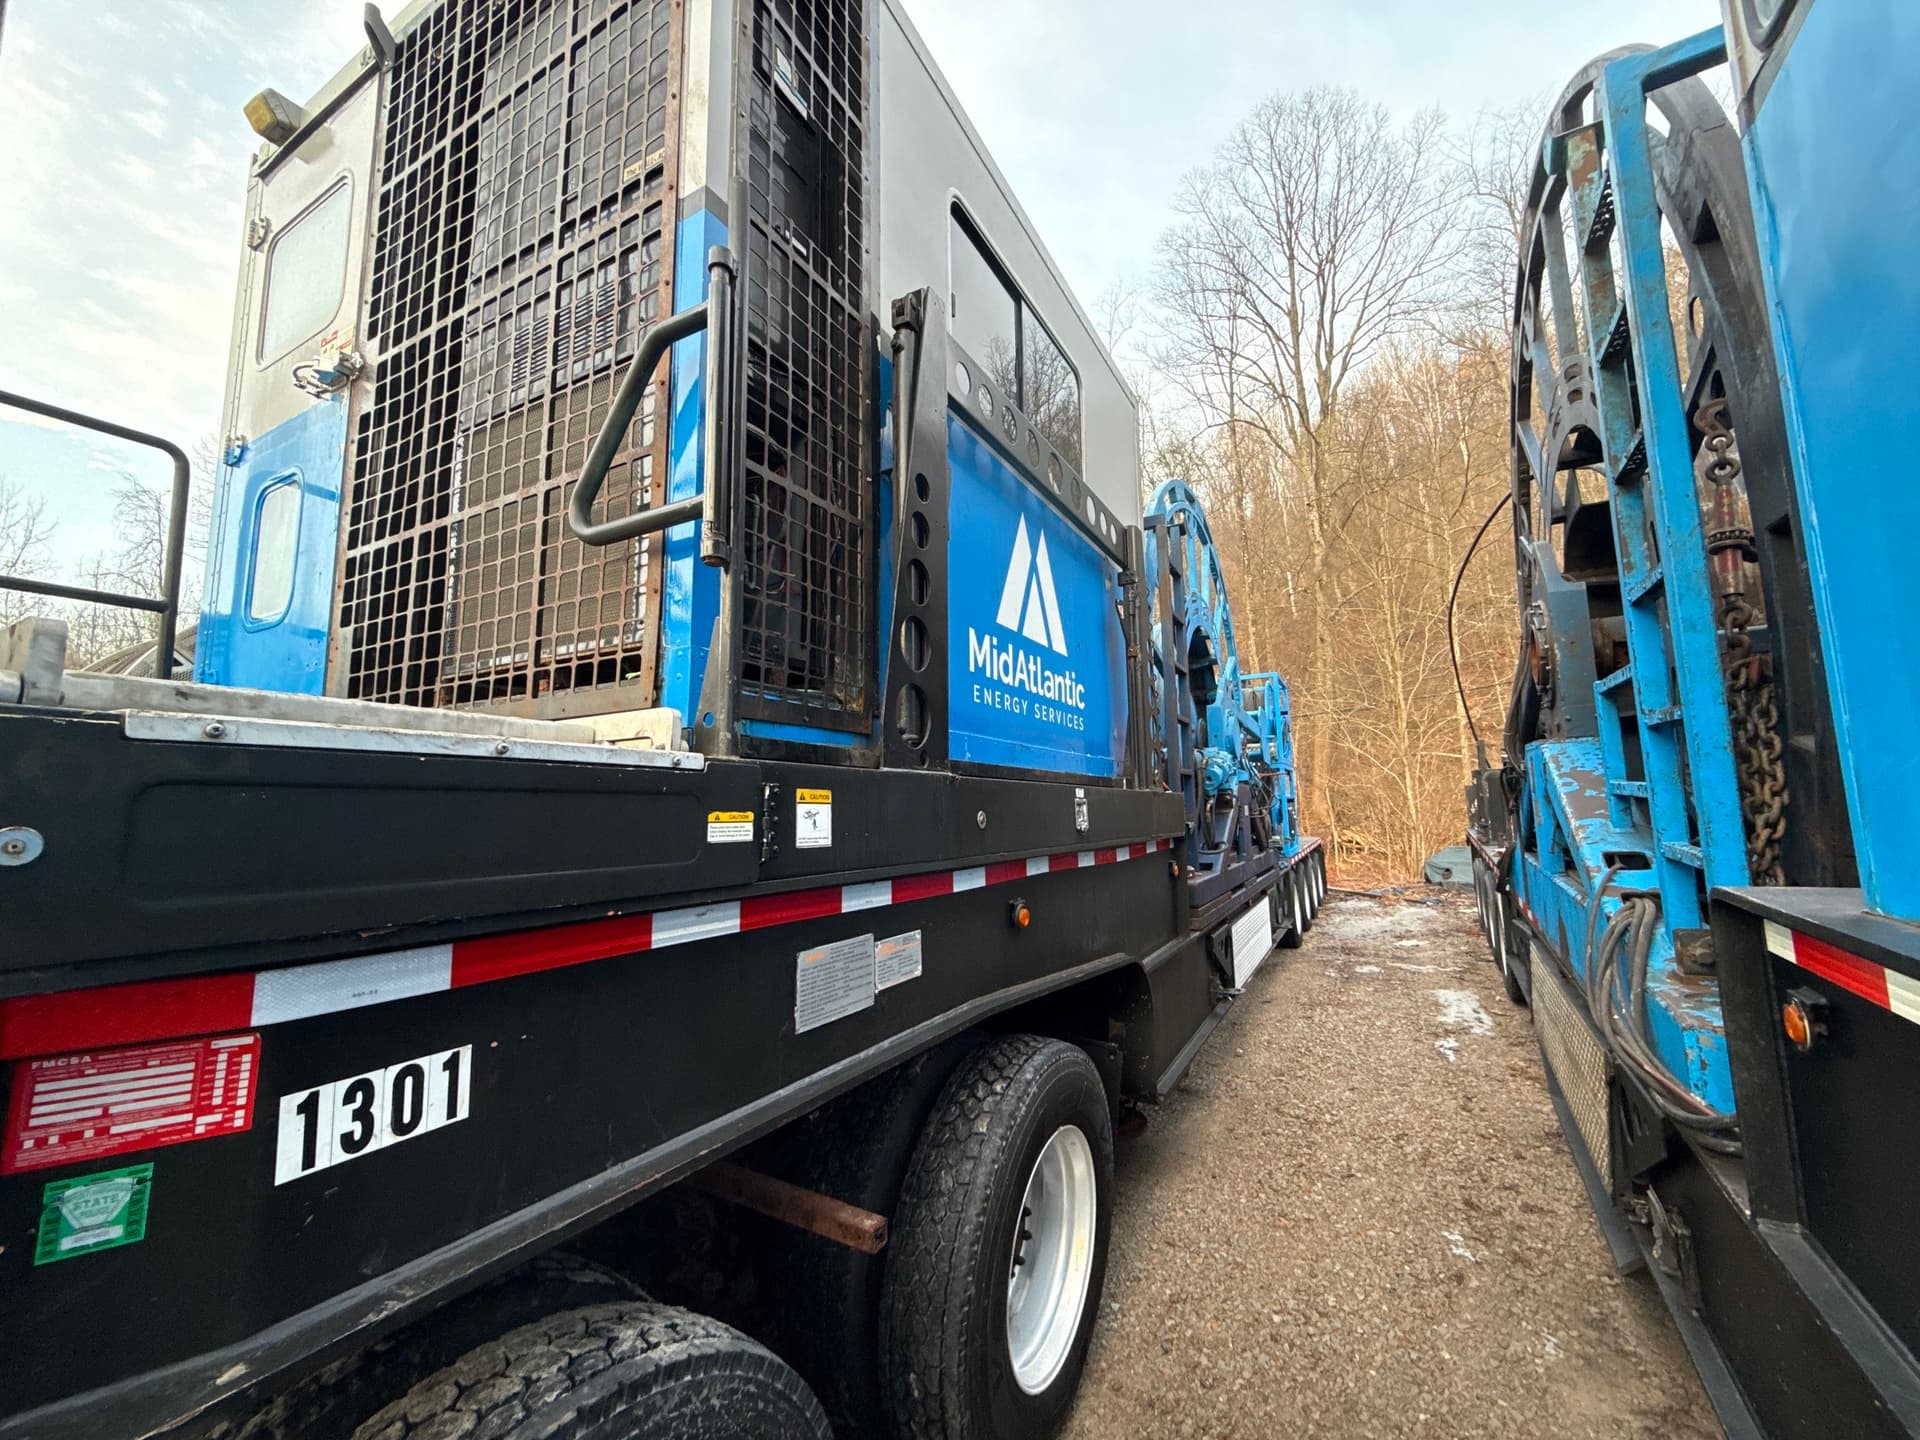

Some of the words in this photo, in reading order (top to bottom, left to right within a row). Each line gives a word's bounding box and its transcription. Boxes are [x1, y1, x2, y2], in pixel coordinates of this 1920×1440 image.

[968, 626, 1086, 710] MidAtlantic
[973, 684, 1028, 716] ENERGY
[1034, 703, 1084, 731] SERVICES
[809, 793, 830, 801] CAUTION
[31, 1055, 92, 1070] FMCSA
[296, 1050, 461, 1172] 1301
[73, 1192, 120, 1212] STATE
